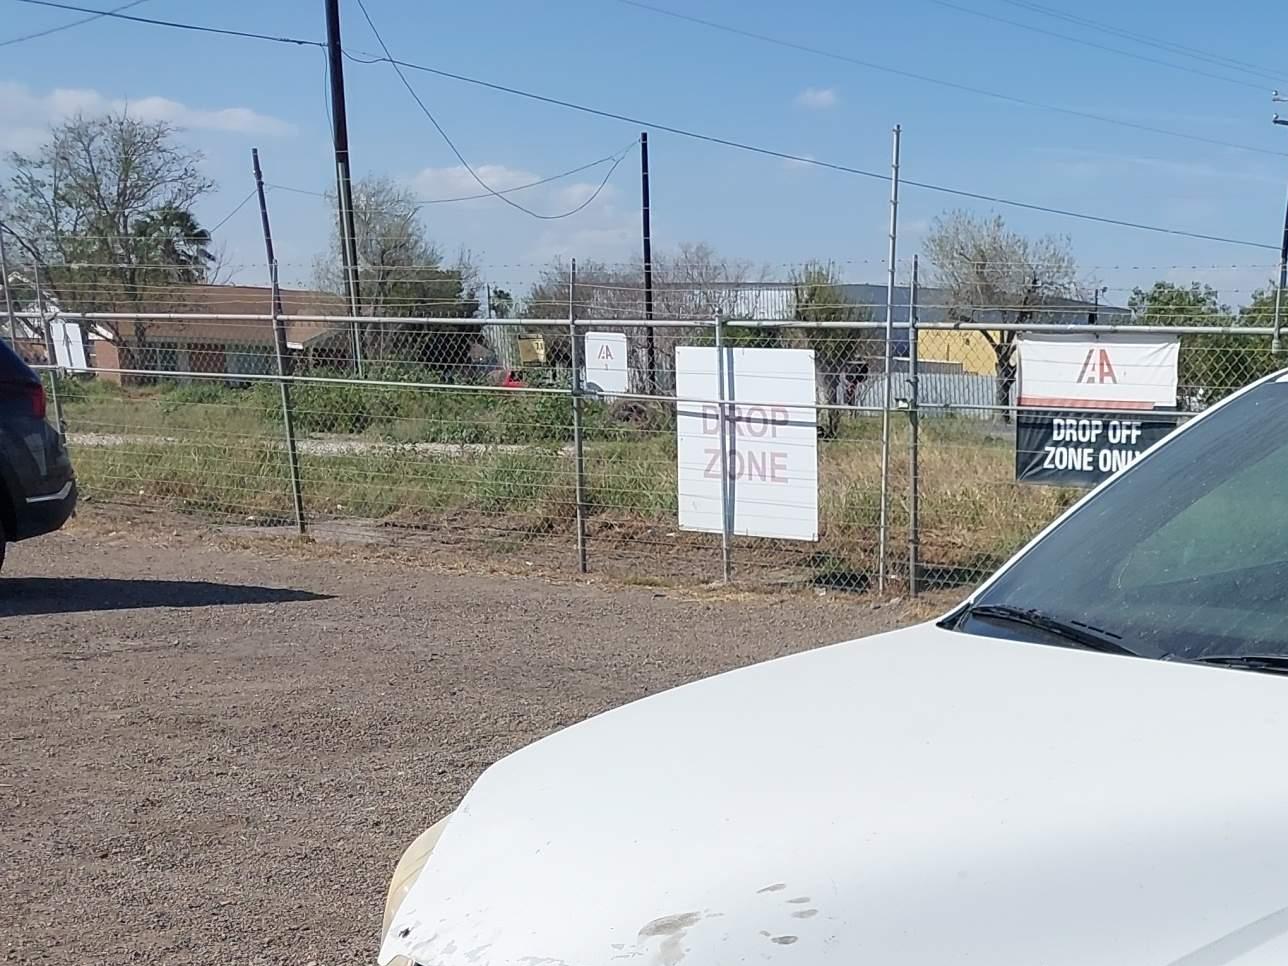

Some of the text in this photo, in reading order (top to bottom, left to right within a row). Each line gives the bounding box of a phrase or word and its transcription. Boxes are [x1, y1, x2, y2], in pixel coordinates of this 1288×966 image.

[702, 404, 789, 438] DROP
[1052, 418, 1142, 444] DROP OFF
[703, 448, 790, 483] ZONE
[1043, 447, 1094, 471] ZONE
